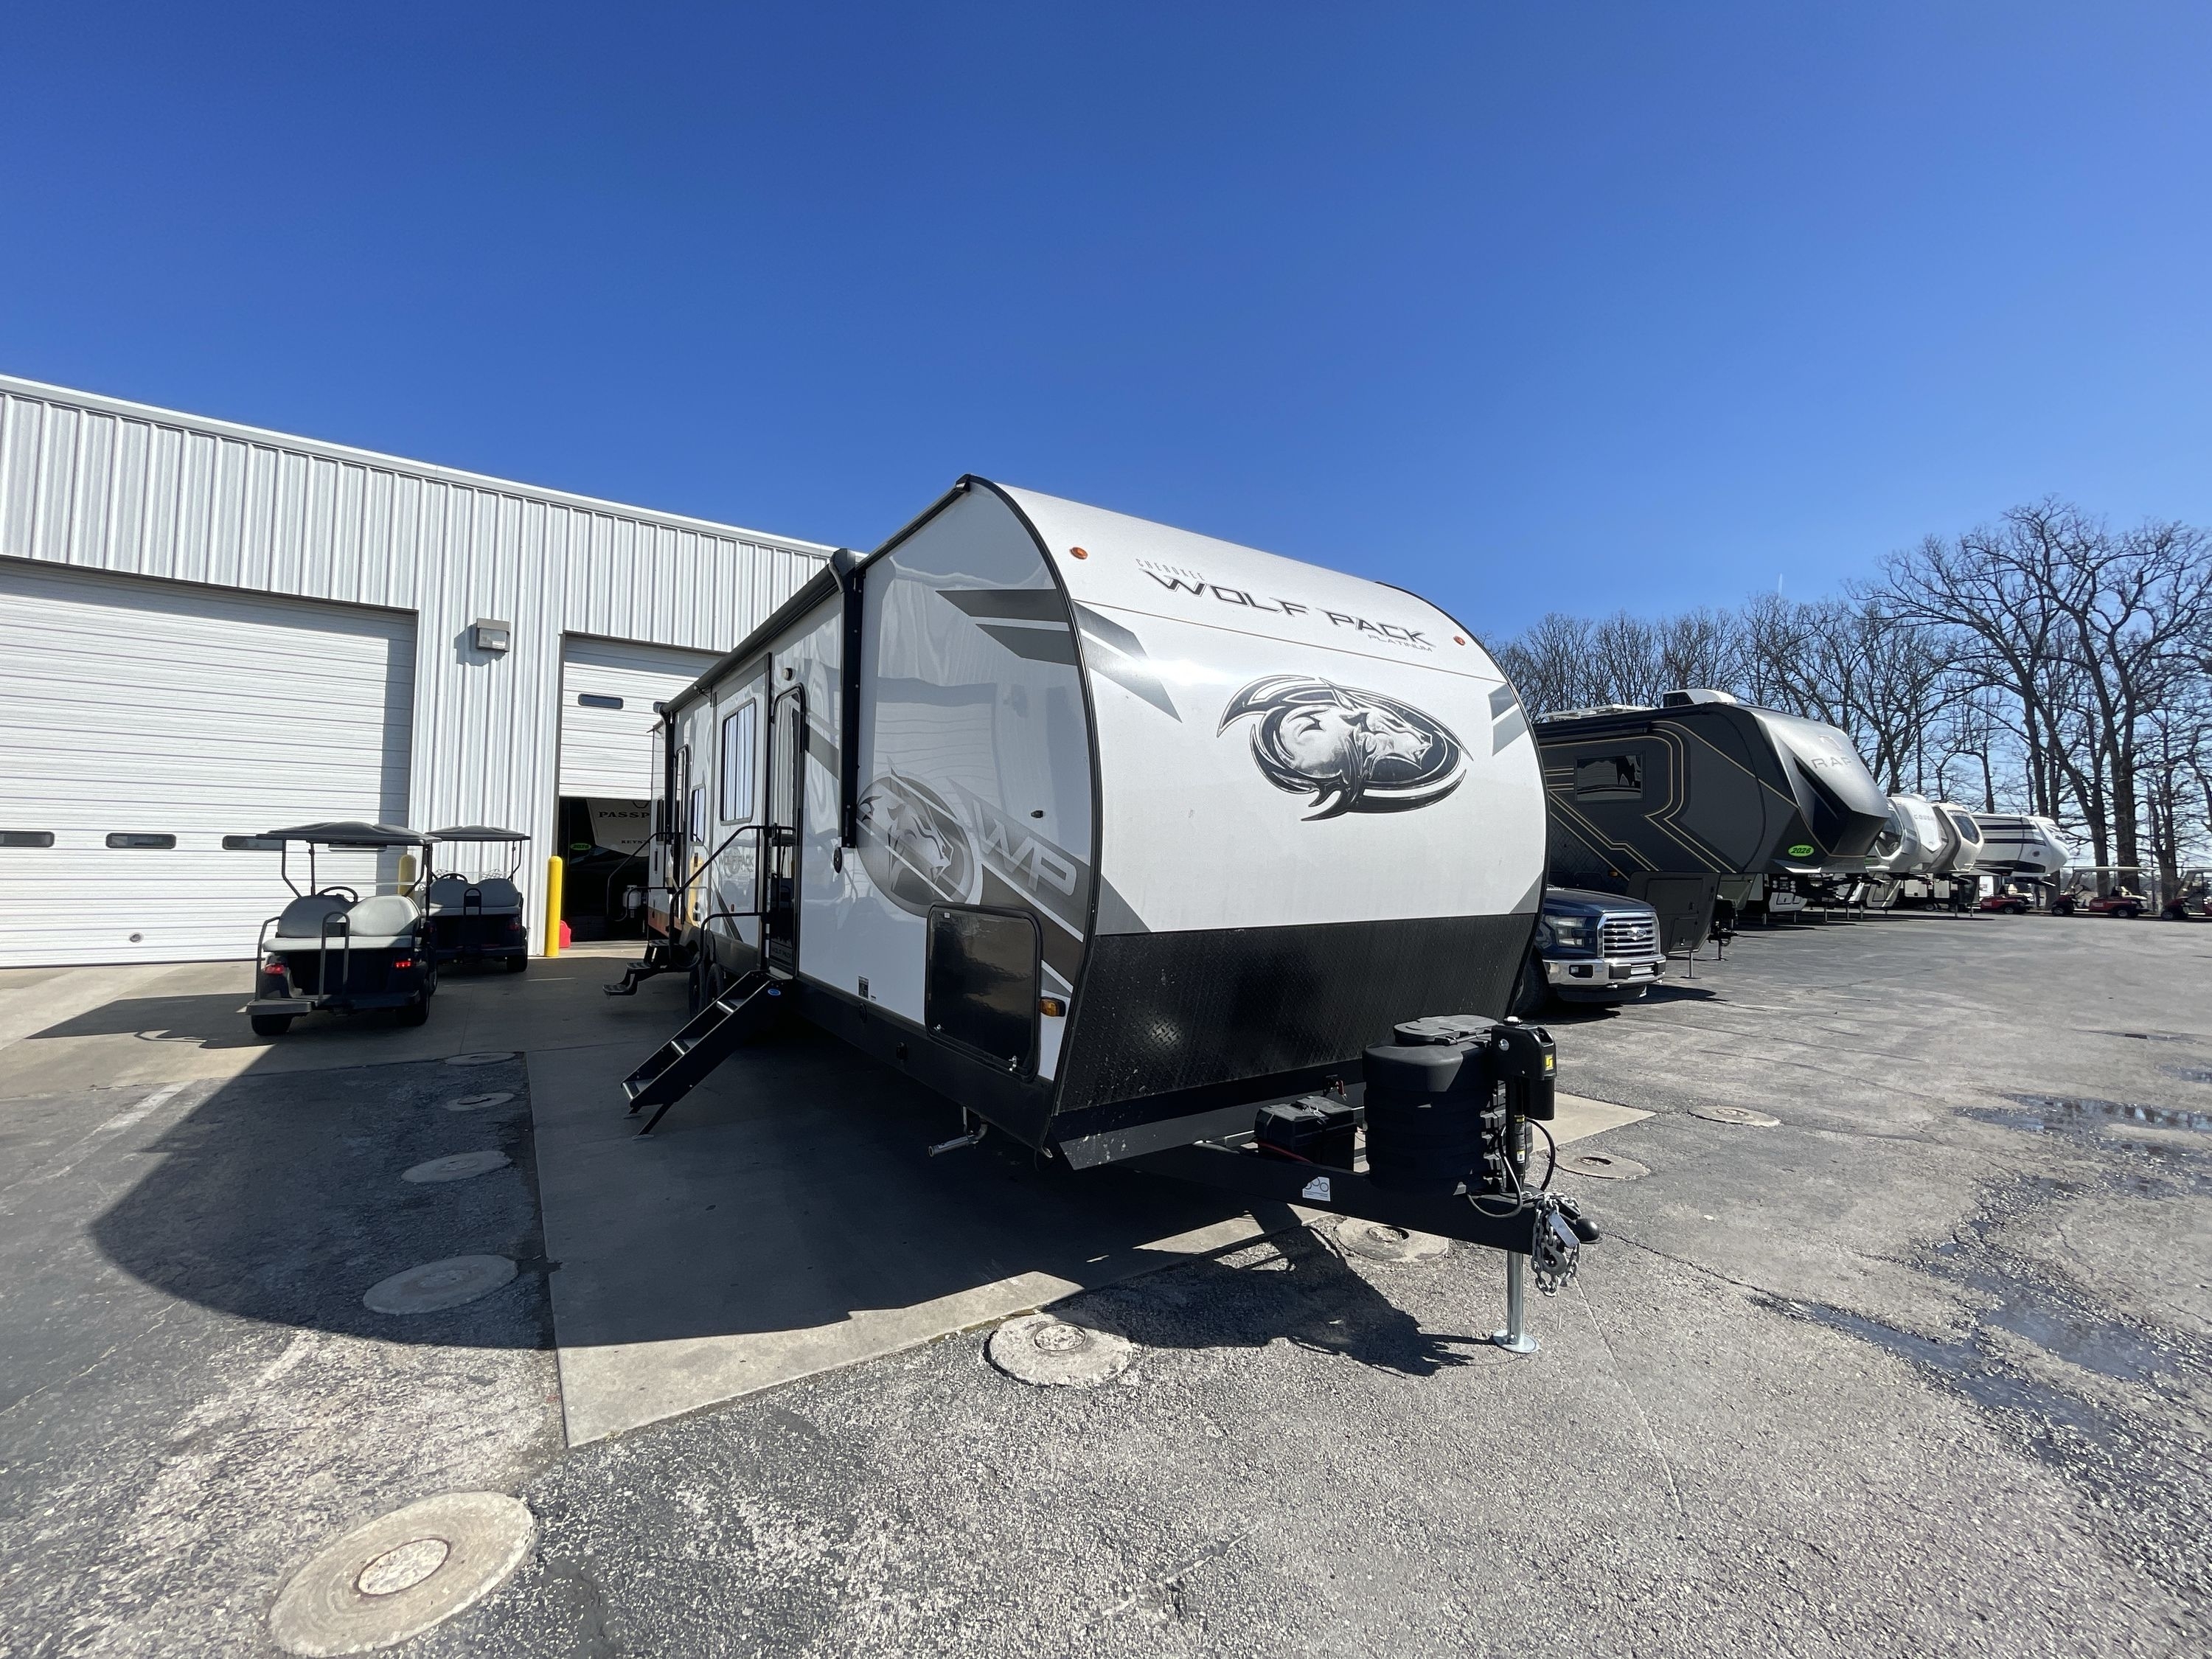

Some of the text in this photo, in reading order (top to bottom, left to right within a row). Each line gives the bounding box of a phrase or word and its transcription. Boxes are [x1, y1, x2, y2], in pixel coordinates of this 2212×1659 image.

[1135, 558, 1206, 581] CHEROKEE
[1138, 568, 1436, 648] WOLF PACK
[1368, 633, 1433, 653] PLATINUM
